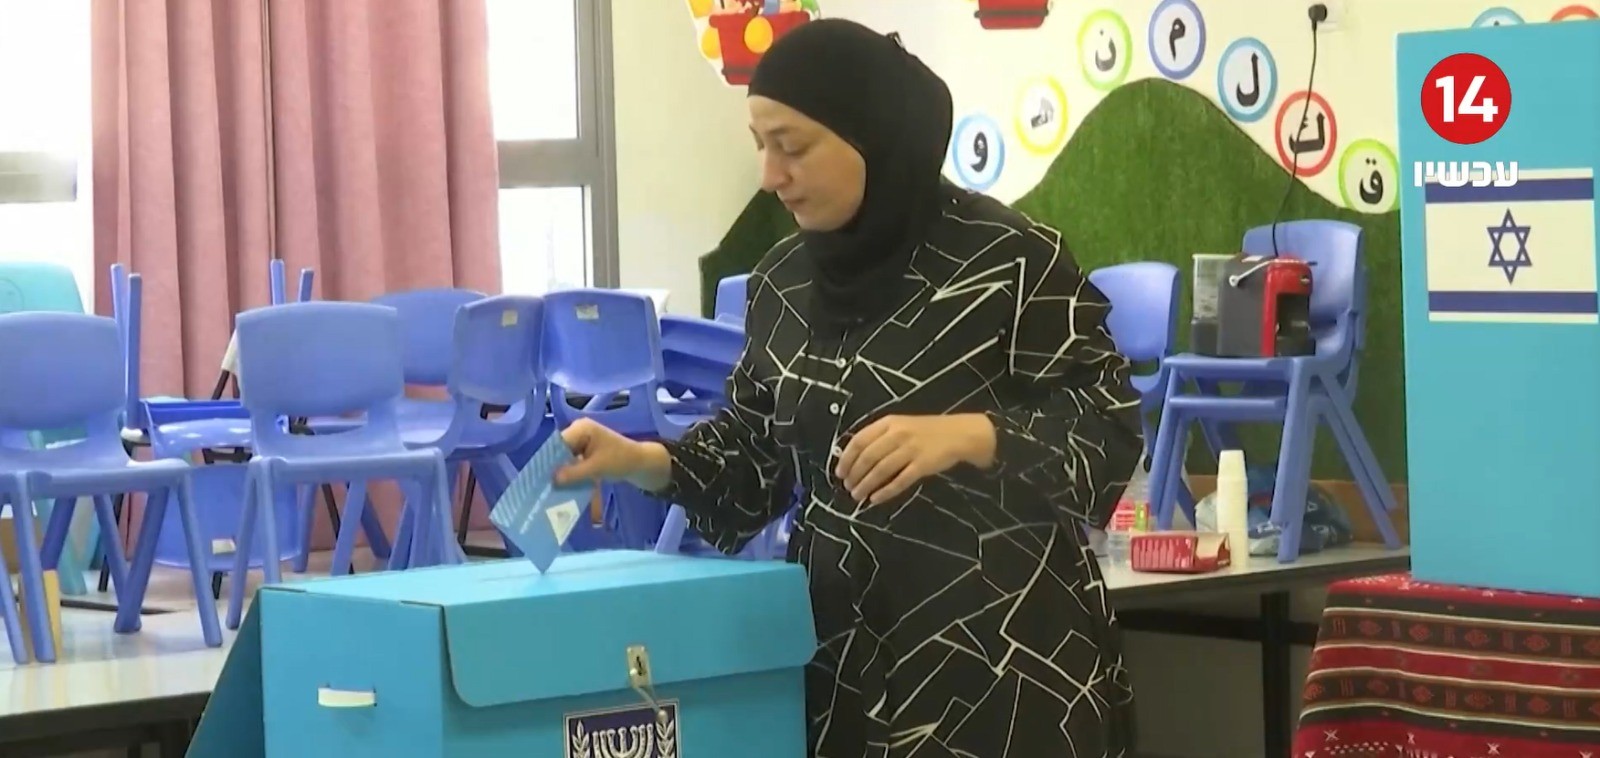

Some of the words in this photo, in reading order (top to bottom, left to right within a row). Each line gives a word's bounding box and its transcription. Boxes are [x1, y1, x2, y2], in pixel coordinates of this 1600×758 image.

[1095, 28, 1116, 72] ن
[1165, 17, 1186, 62] م
[1236, 52, 1259, 107] ل
[970, 131, 988, 173] و
[1289, 111, 1325, 155] ك
[1359, 157, 1383, 205] ق
